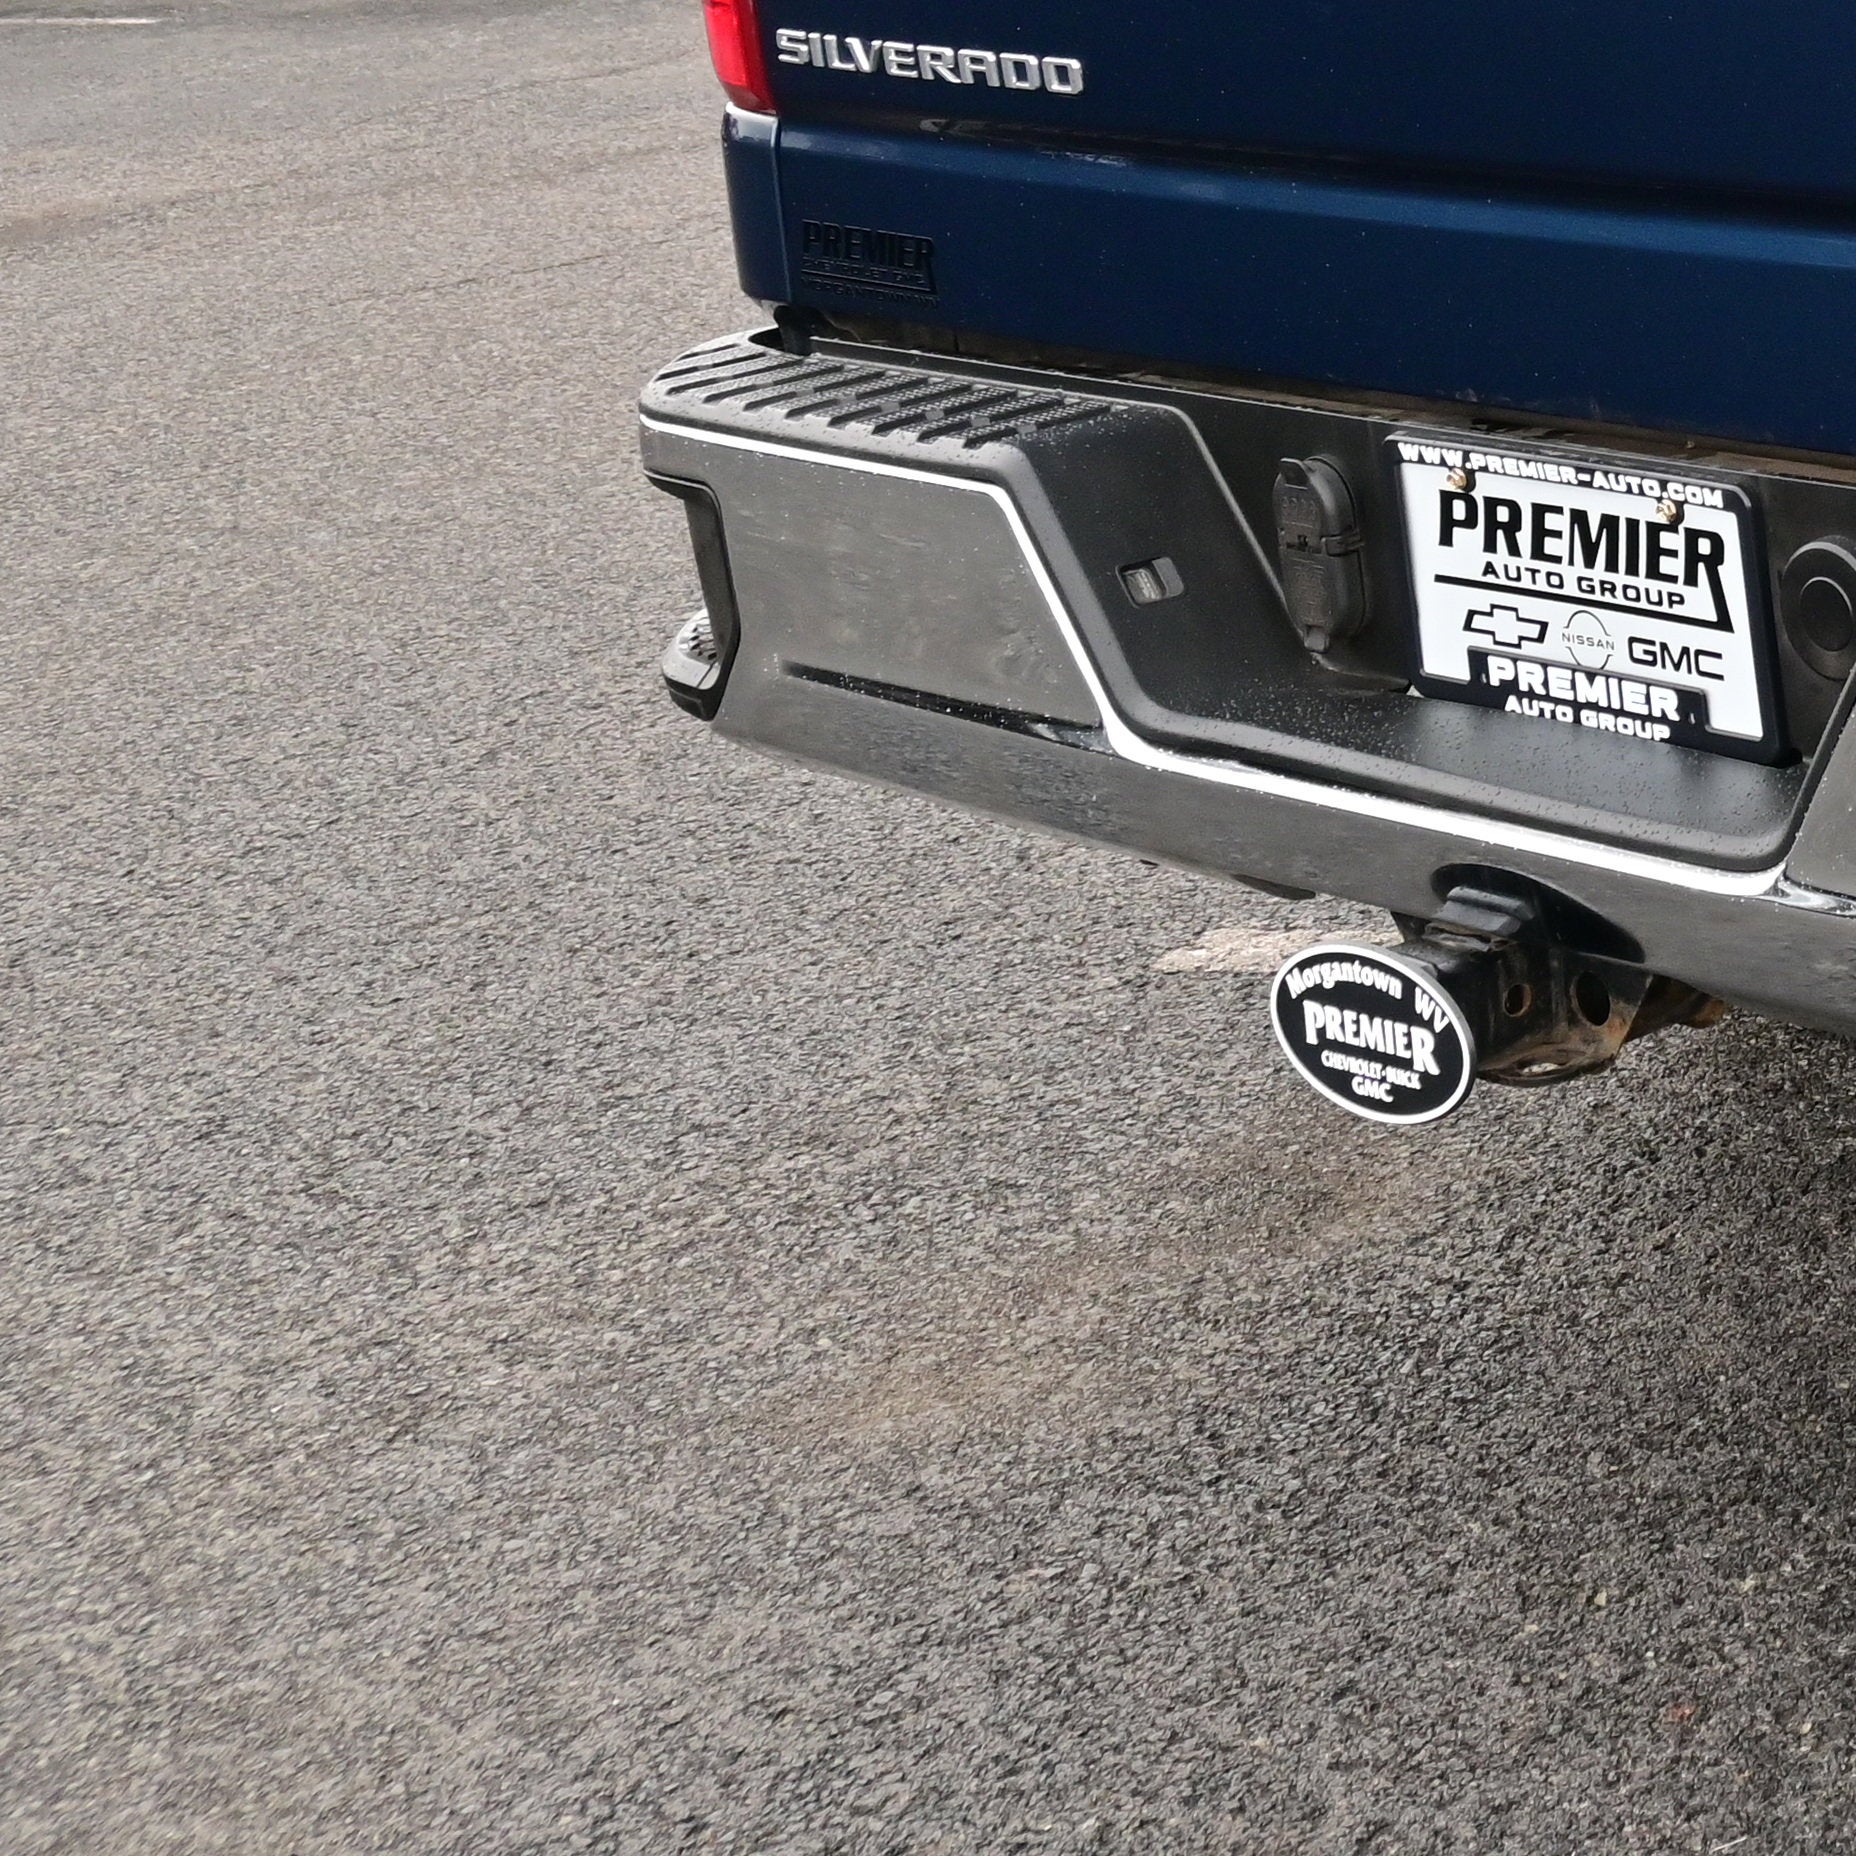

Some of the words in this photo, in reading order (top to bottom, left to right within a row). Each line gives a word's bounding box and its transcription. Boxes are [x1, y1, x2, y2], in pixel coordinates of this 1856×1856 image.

[775, 28, 1085, 95] SILVERADO
[801, 219, 937, 282] PREMIER
[1397, 442, 1724, 509] WWW.PREMIER-AUTO.COM
[1438, 489, 1728, 590] PREMIER
[1481, 561, 1565, 590] AUTO
[1577, 577, 1686, 609] GROUP
[1561, 632, 1615, 652] NISSAN
[1627, 635, 1725, 681] GMC
[1487, 656, 1680, 721] PREMIER
[1504, 695, 1574, 723] AUTO
[1580, 709, 1671, 742] GROUP
[1284, 960, 1403, 1000] Morgantown
[1414, 987, 1450, 1034] WV
[1302, 999, 1441, 1076] PREMIER
[1351, 1076, 1394, 1103] GMC
